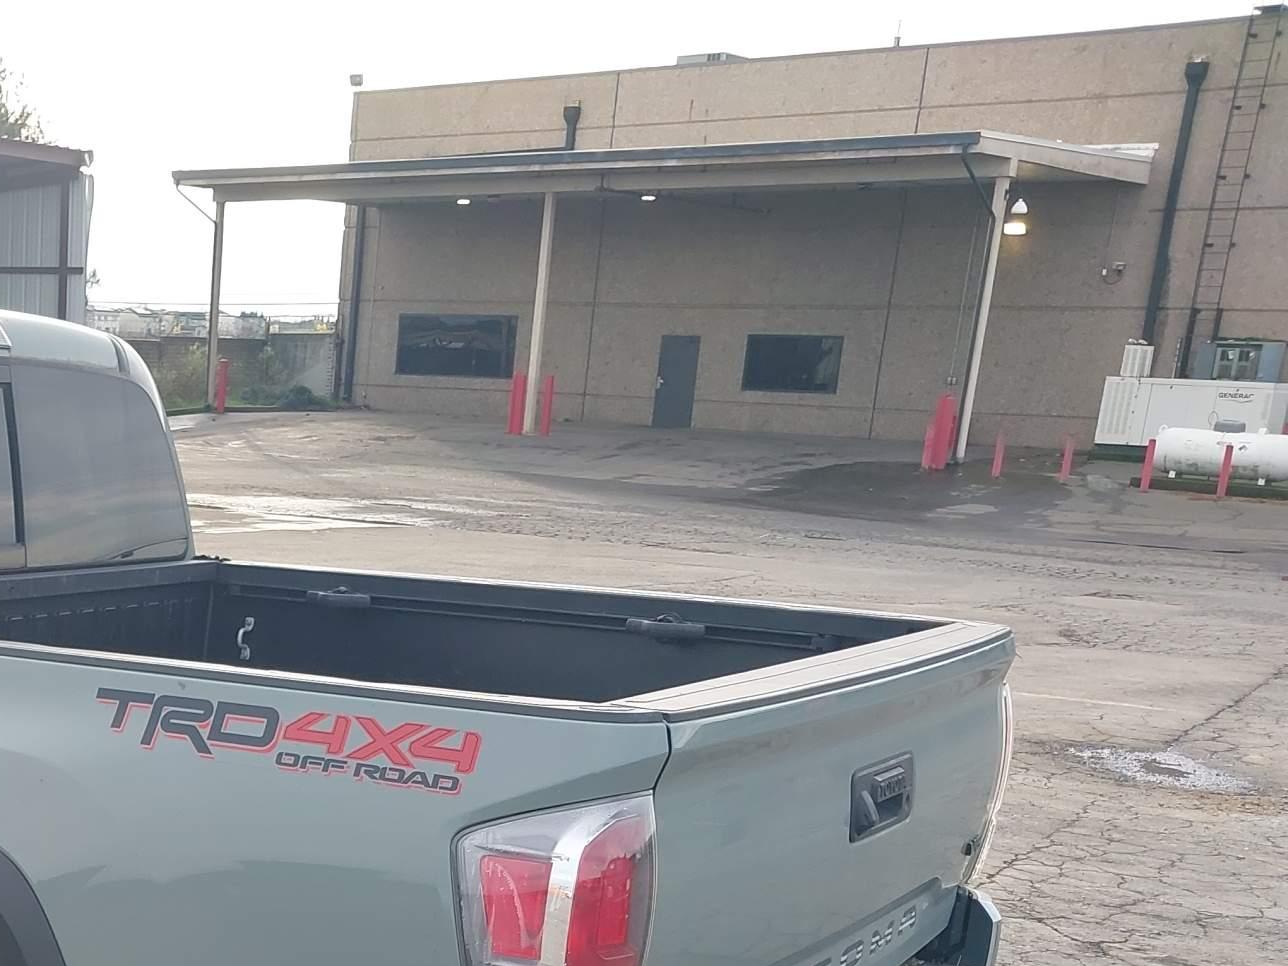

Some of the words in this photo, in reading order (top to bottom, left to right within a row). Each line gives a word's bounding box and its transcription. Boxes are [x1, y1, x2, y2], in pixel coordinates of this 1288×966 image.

[95, 687, 284, 759] TRD
[275, 751, 352, 777] OFF
[352, 762, 463, 795] ROAD
